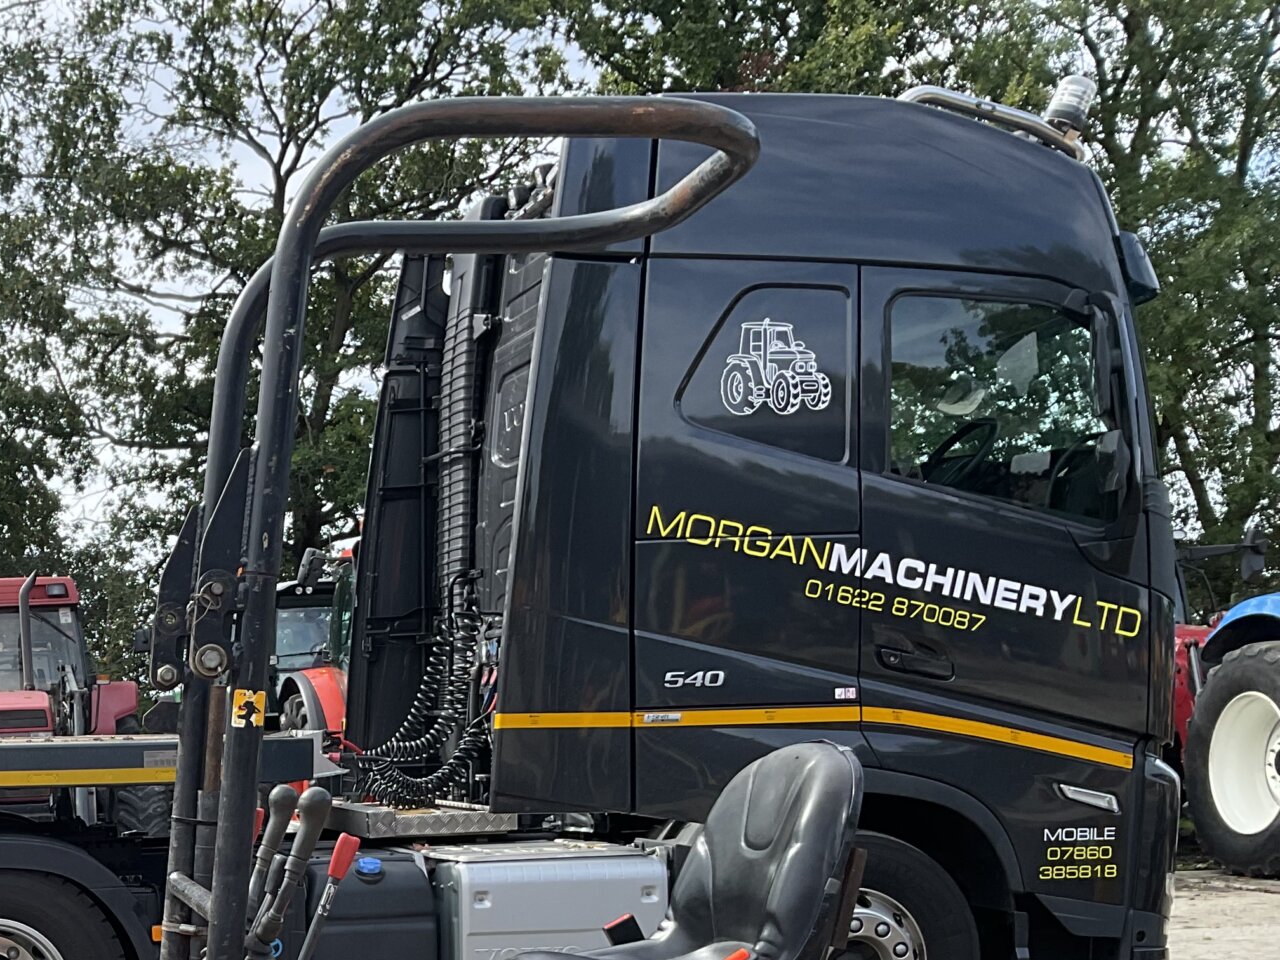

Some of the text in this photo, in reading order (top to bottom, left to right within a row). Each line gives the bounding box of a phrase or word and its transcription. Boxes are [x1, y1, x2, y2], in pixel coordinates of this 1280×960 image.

[804, 579, 987, 632] 01622 870087
[664, 670, 726, 688] 540
[1043, 827, 1116, 842] MOBILE
[1047, 846, 1113, 860] 07860
[1039, 864, 1117, 880] 385818
